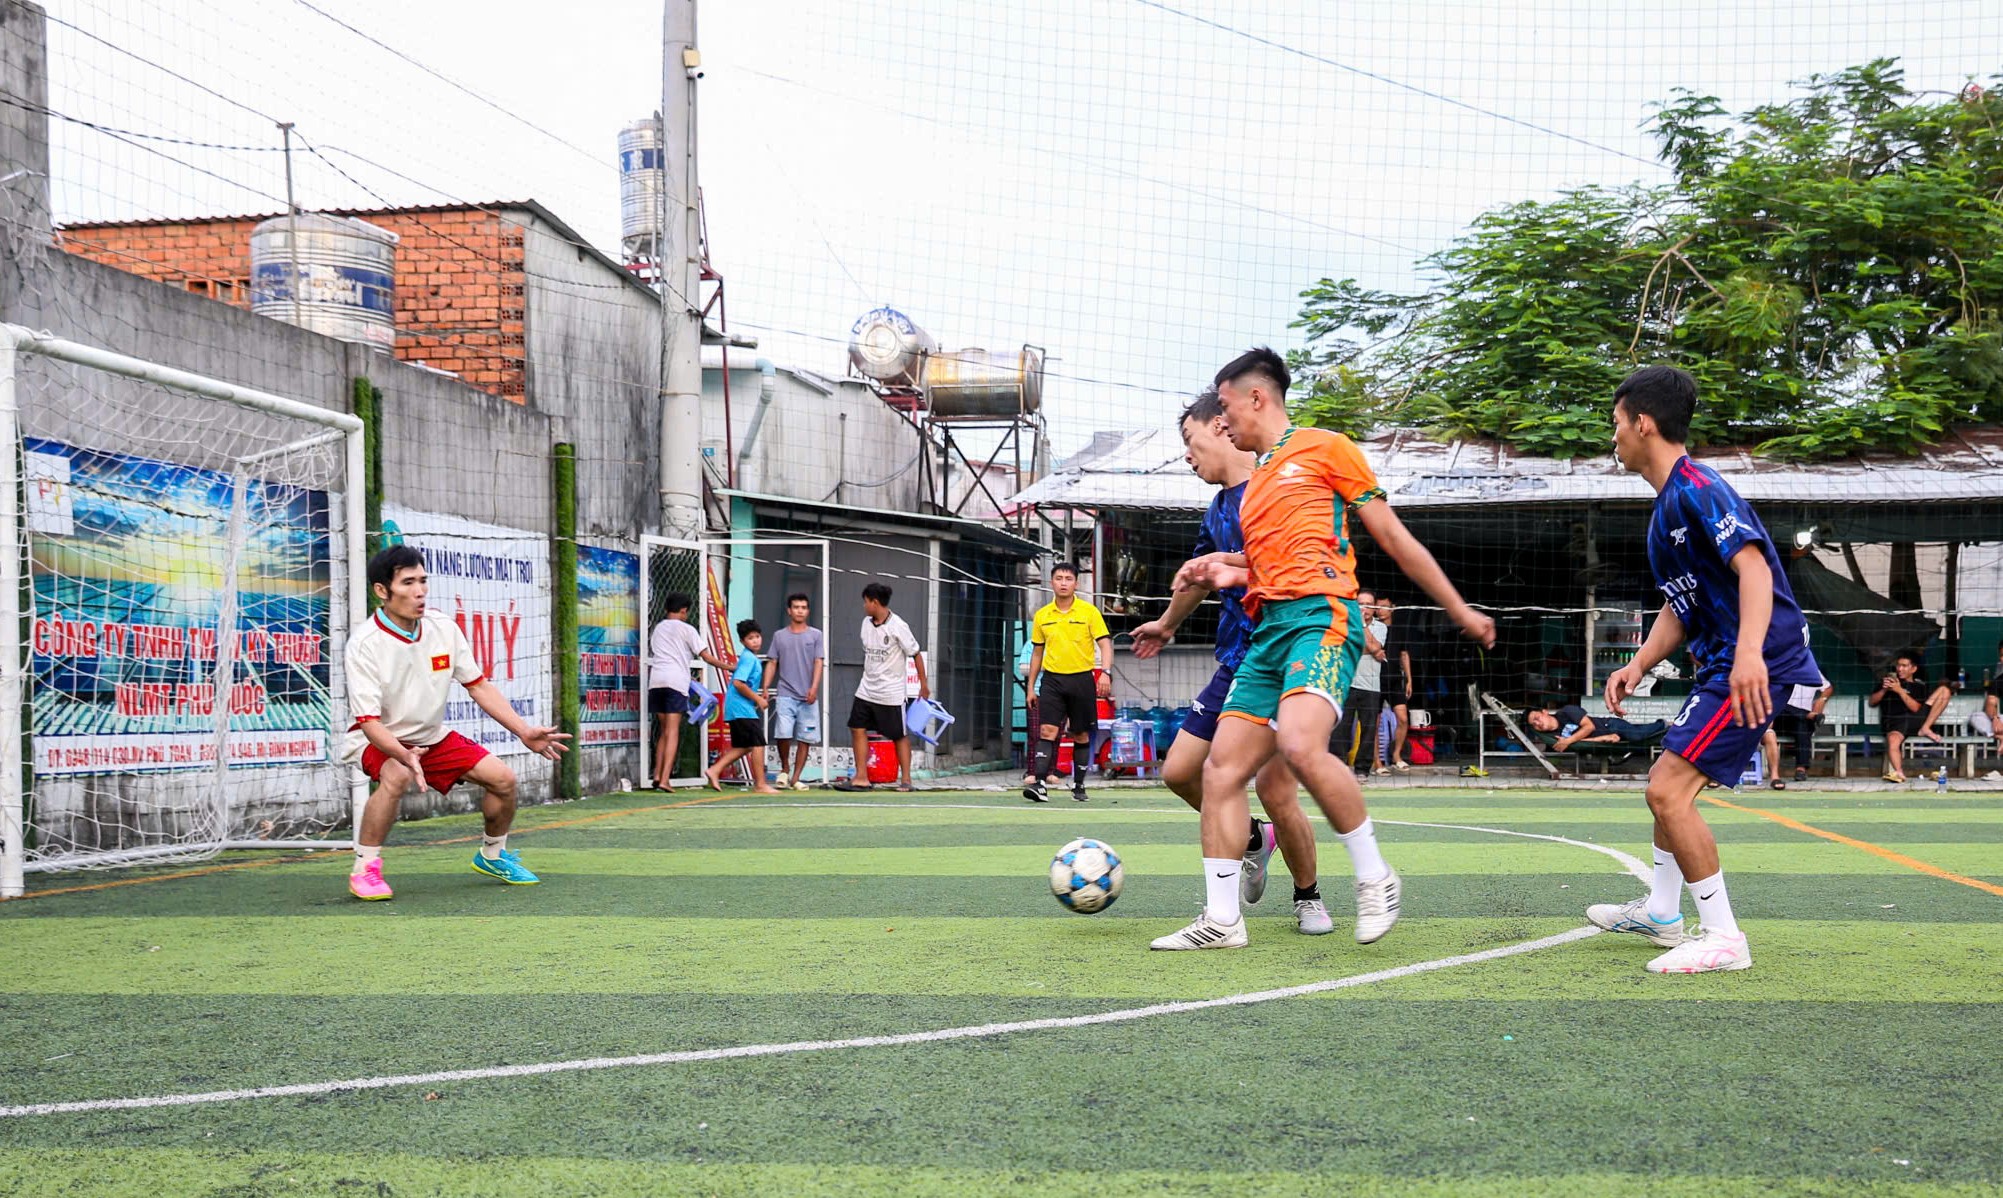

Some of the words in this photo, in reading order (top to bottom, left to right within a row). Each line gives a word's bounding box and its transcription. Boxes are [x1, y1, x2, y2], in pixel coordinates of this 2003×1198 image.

[35, 612, 98, 658] CÔNG
[103, 622, 127, 659] TY
[132, 624, 185, 660] TNHH
[188, 627, 215, 661] TM
[272, 628, 322, 671] THUẬT
[116, 682, 172, 716] NLMT
[176, 676, 214, 716] PHÚ
[227, 673, 266, 716] UỐC
